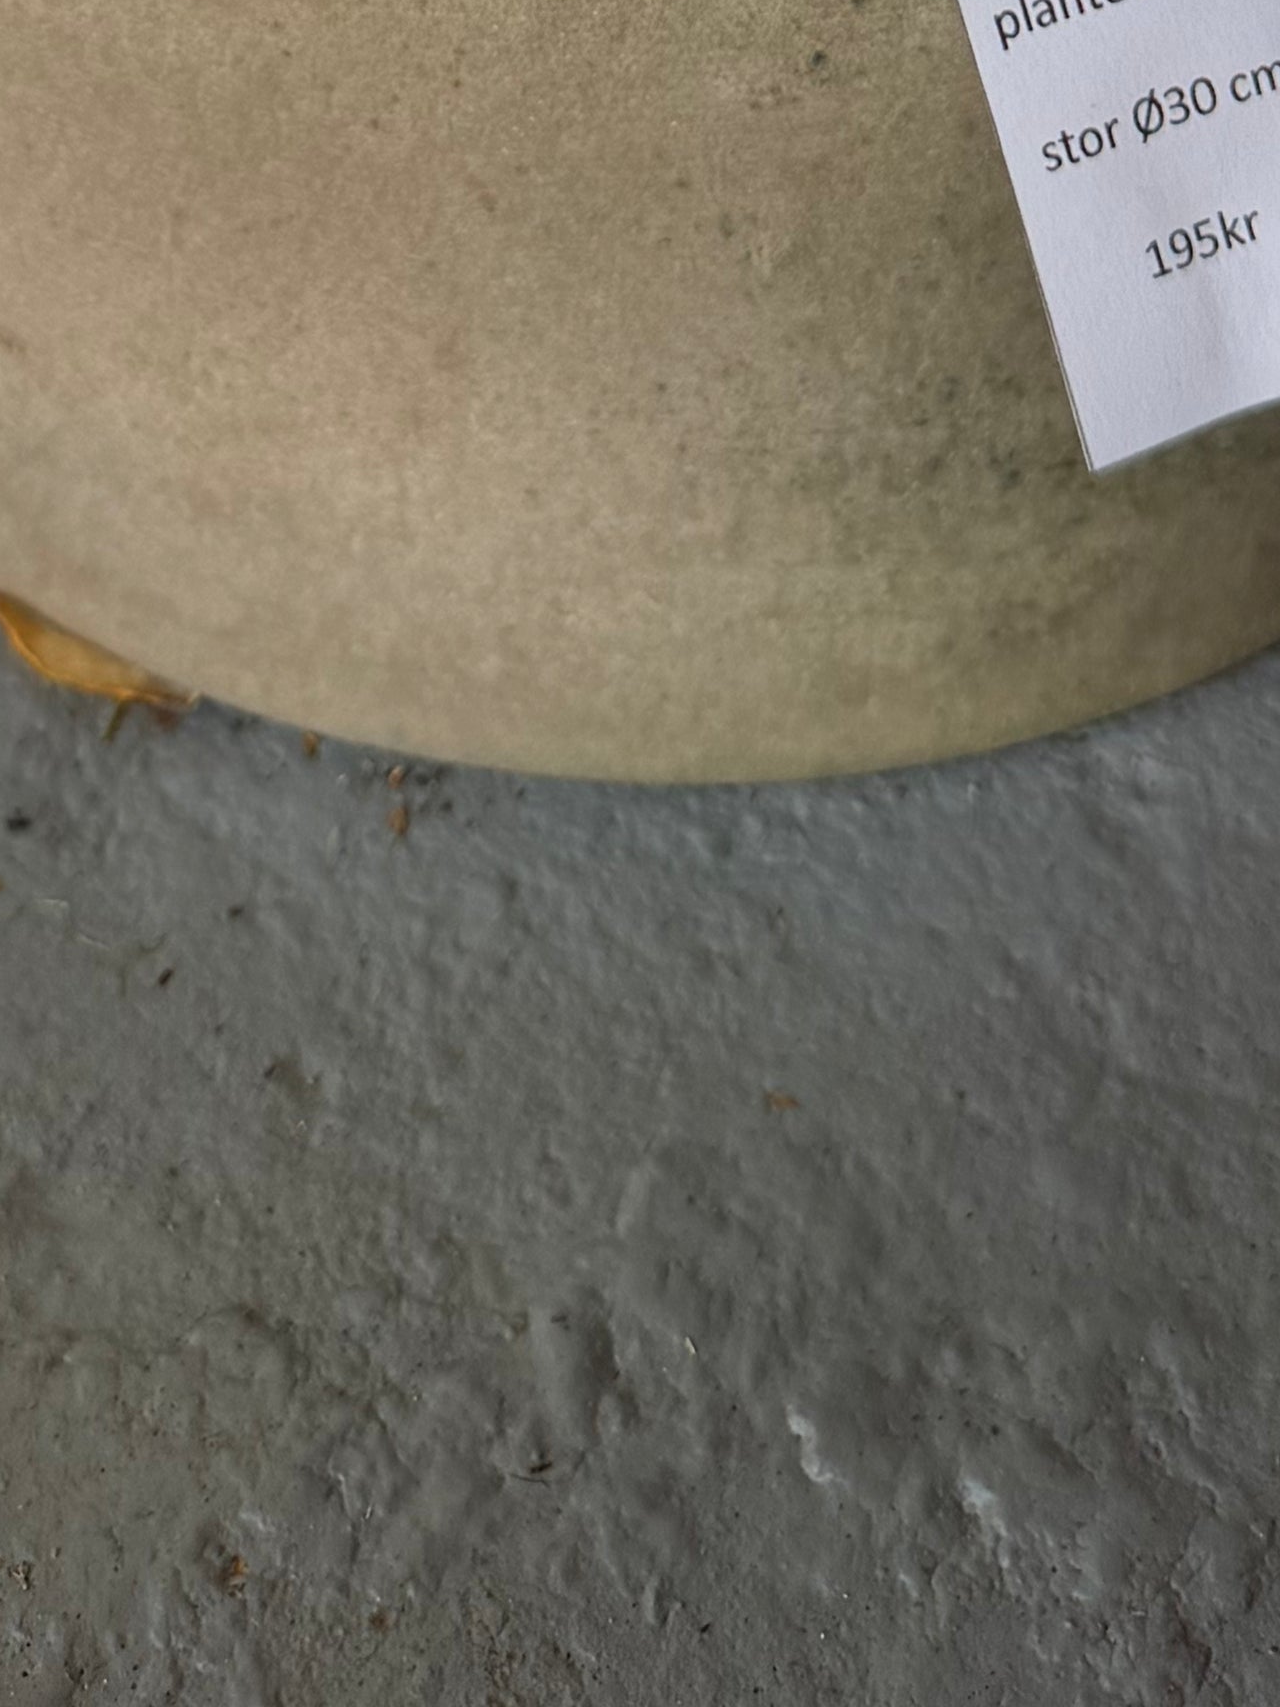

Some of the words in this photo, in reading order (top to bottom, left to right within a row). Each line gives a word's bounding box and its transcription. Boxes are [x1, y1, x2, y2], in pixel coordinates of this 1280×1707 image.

[1041, 117, 1119, 173] stor
[1132, 76, 1218, 145] Ø30
[1145, 210, 1259, 280] 195kr
